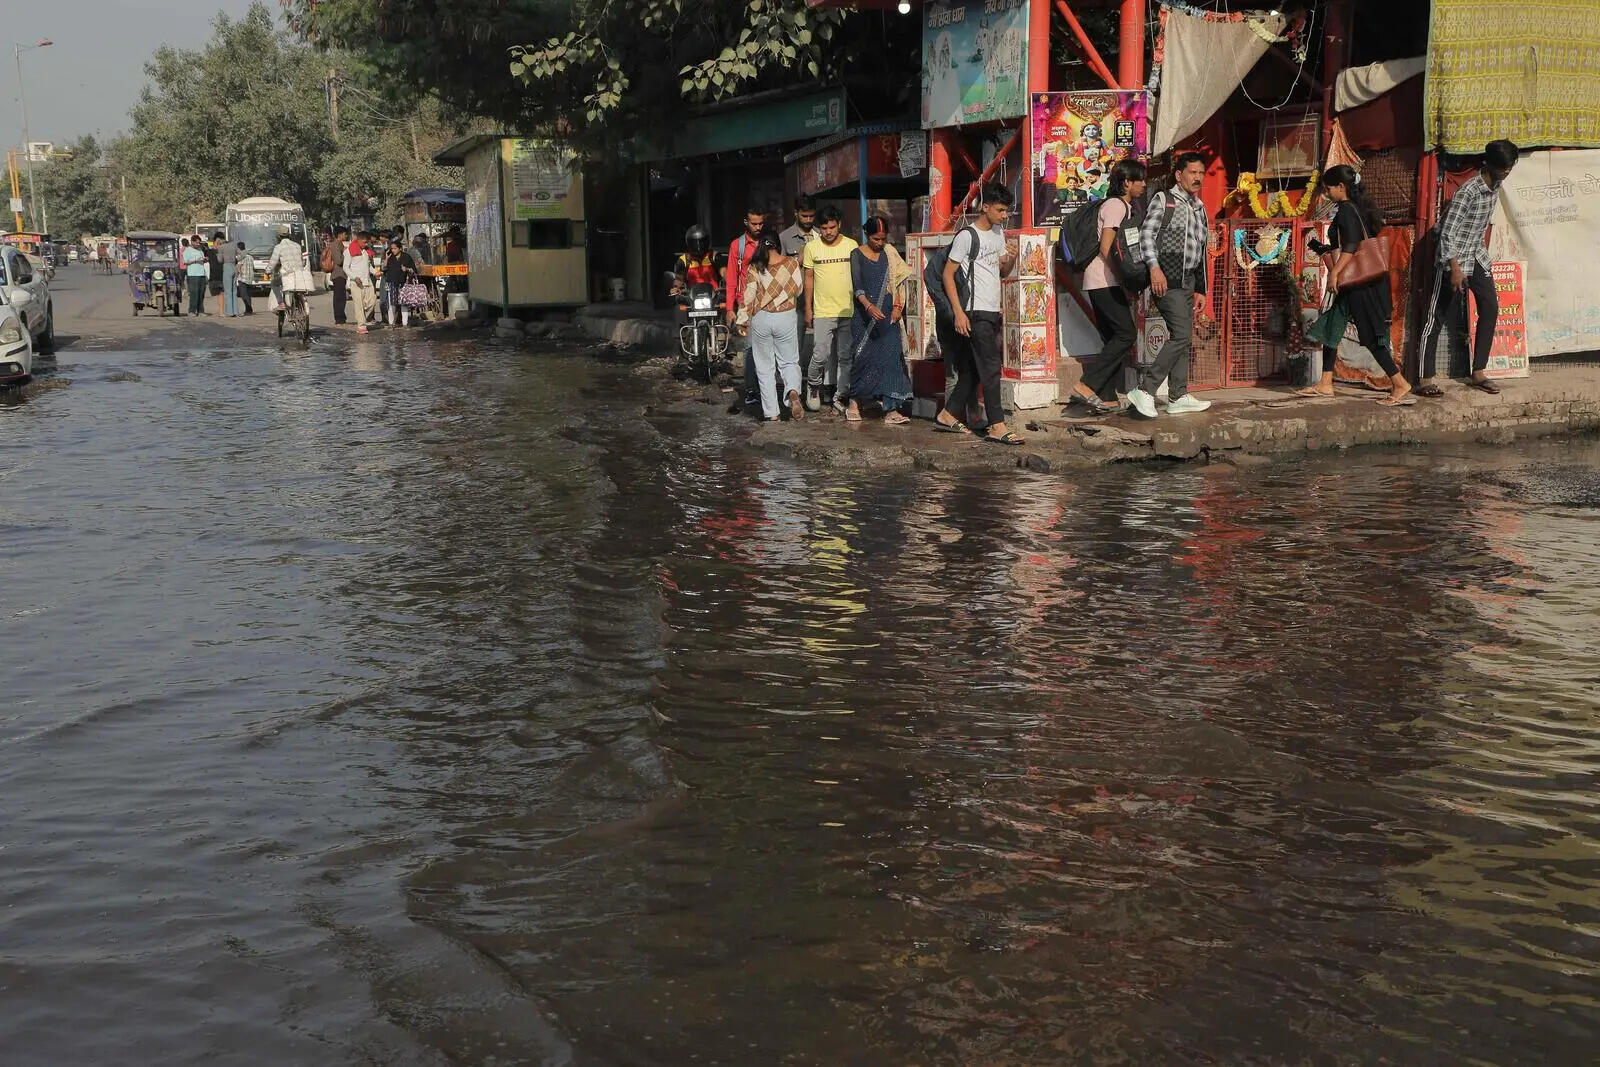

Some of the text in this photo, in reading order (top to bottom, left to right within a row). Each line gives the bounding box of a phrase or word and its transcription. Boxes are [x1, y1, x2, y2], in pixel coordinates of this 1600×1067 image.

[1117, 125, 1133, 137] 05
[235, 212, 298, 222] Uber Shuttle
